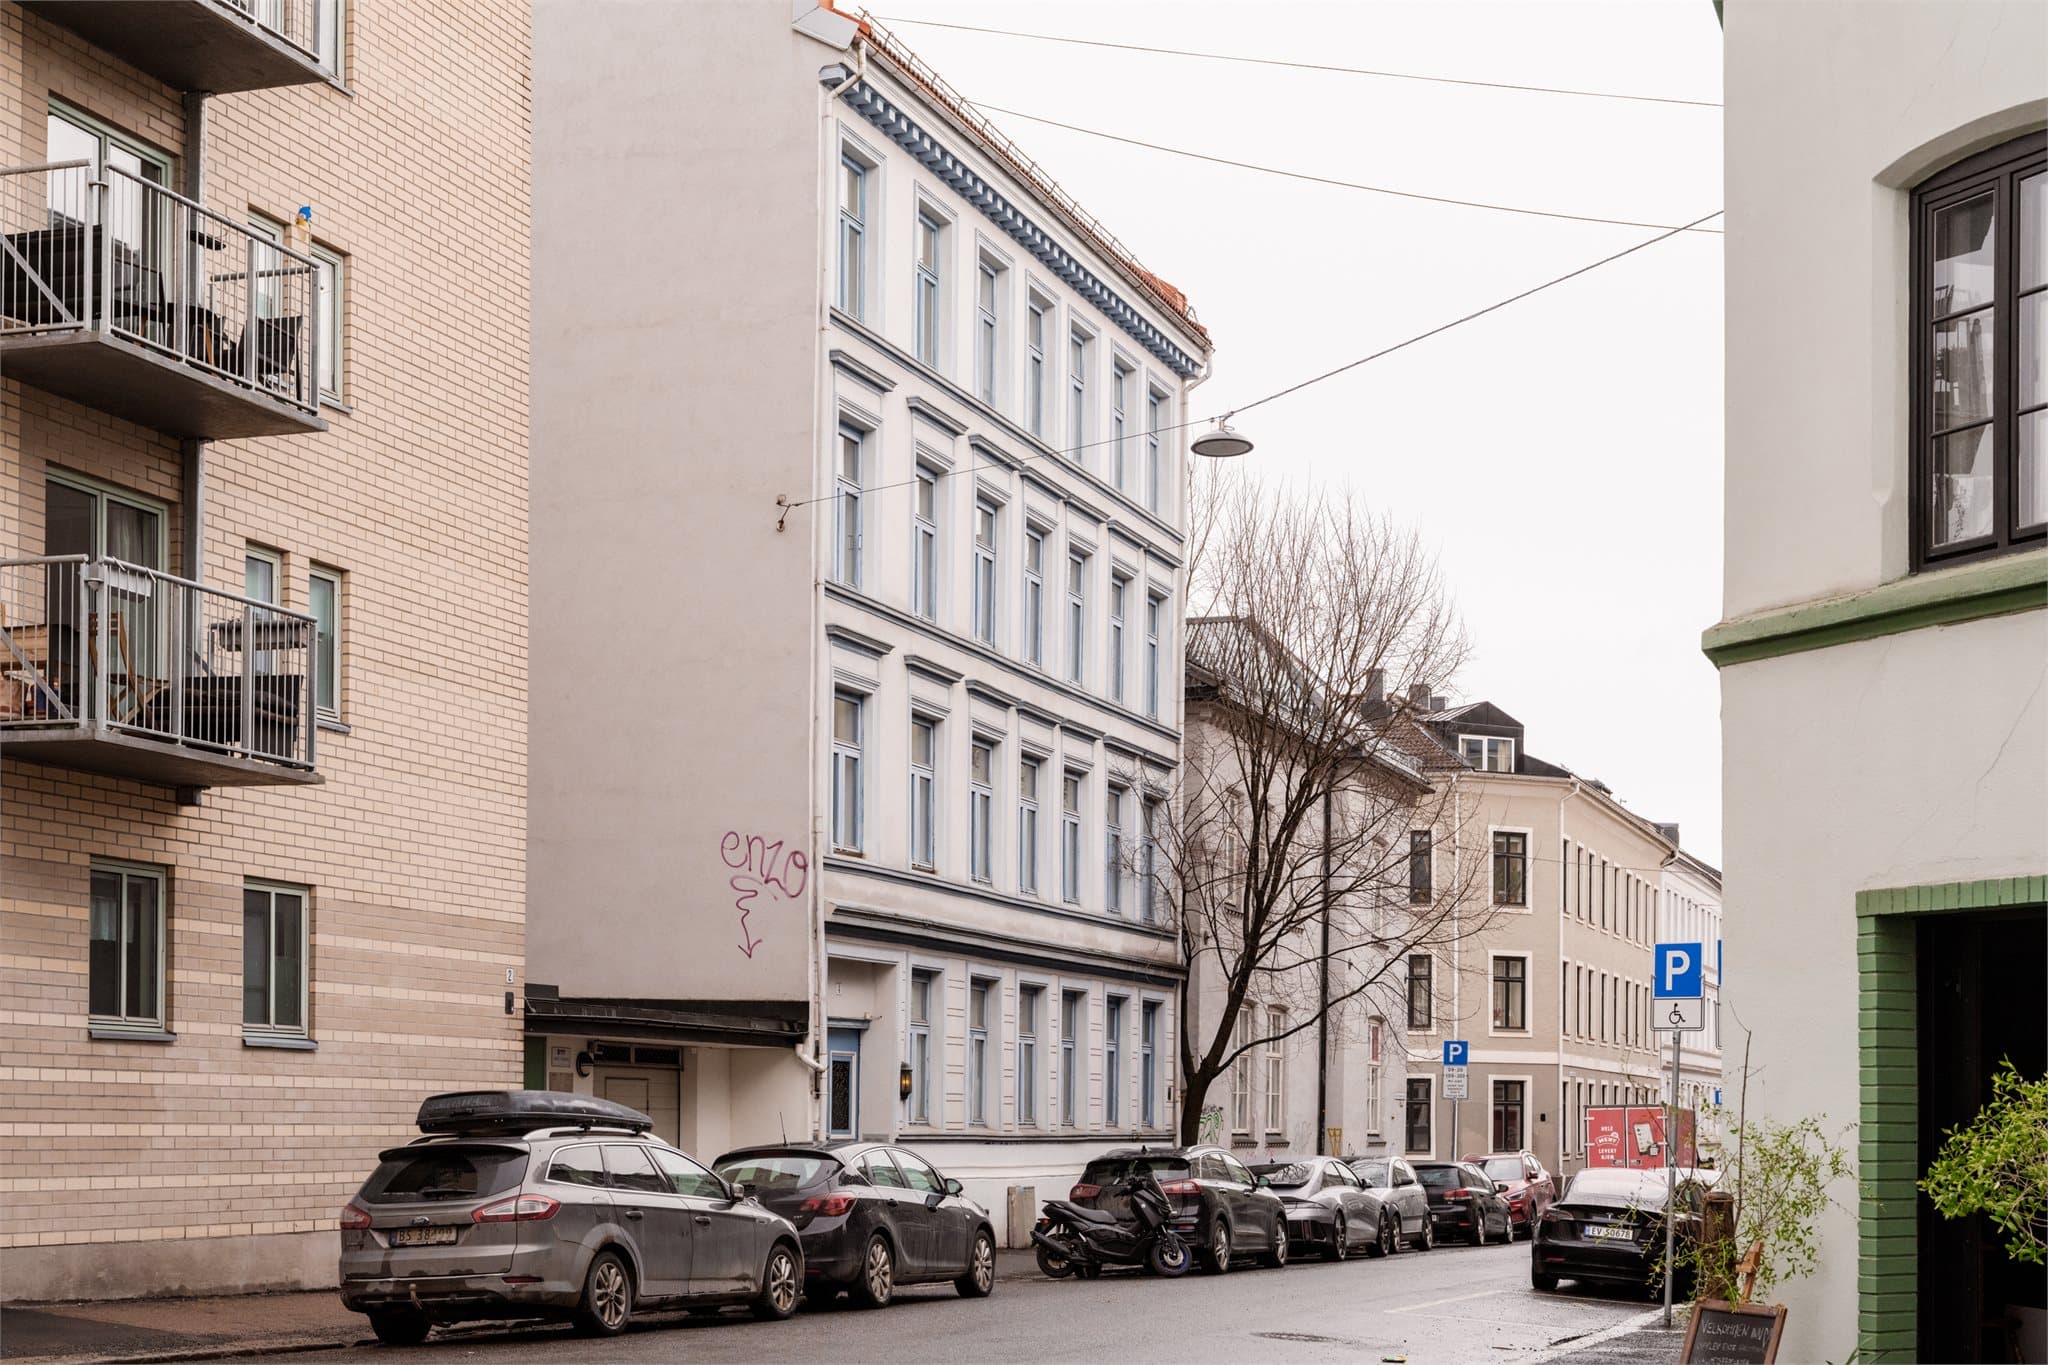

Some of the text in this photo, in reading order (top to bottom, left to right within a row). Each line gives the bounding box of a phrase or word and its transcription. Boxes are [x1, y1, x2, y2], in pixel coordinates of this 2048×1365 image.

[720, 831, 809, 898] enzo
[507, 969, 513, 982] 2
[1665, 950, 1690, 991] P
[1449, 1043, 1463, 1063] P
[399, 1230, 411, 1241] BS
[1591, 1227, 1602, 1236] EV
